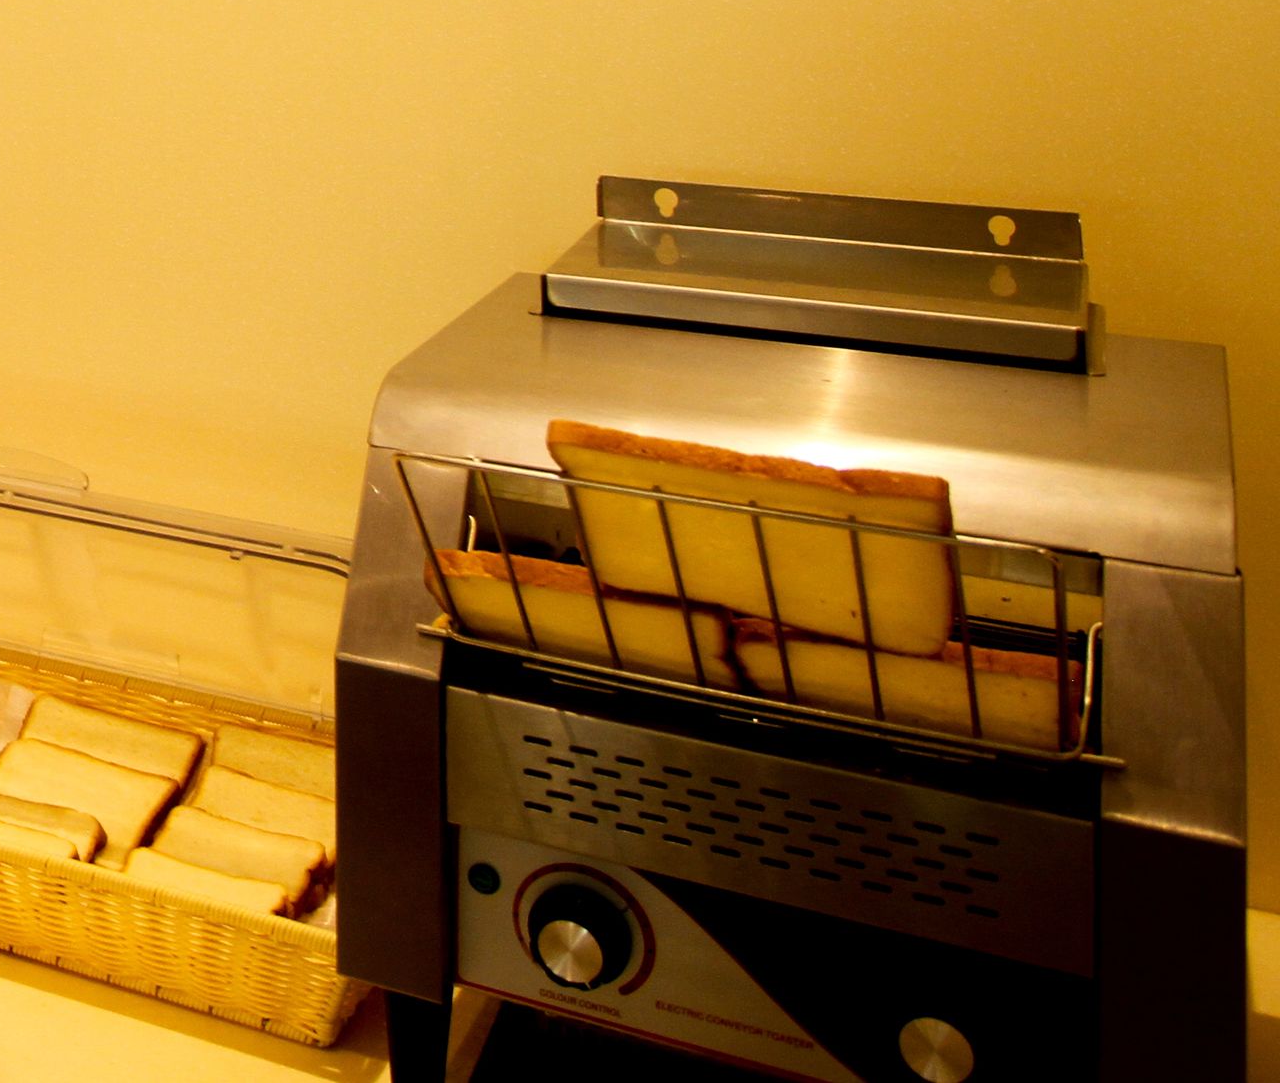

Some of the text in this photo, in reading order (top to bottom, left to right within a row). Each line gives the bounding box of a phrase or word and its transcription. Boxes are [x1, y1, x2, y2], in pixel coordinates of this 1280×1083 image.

[579, 999, 621, 1019] CONTROL
[655, 1000, 814, 1049] ELECTRIC CONVEYOR TOASTER
